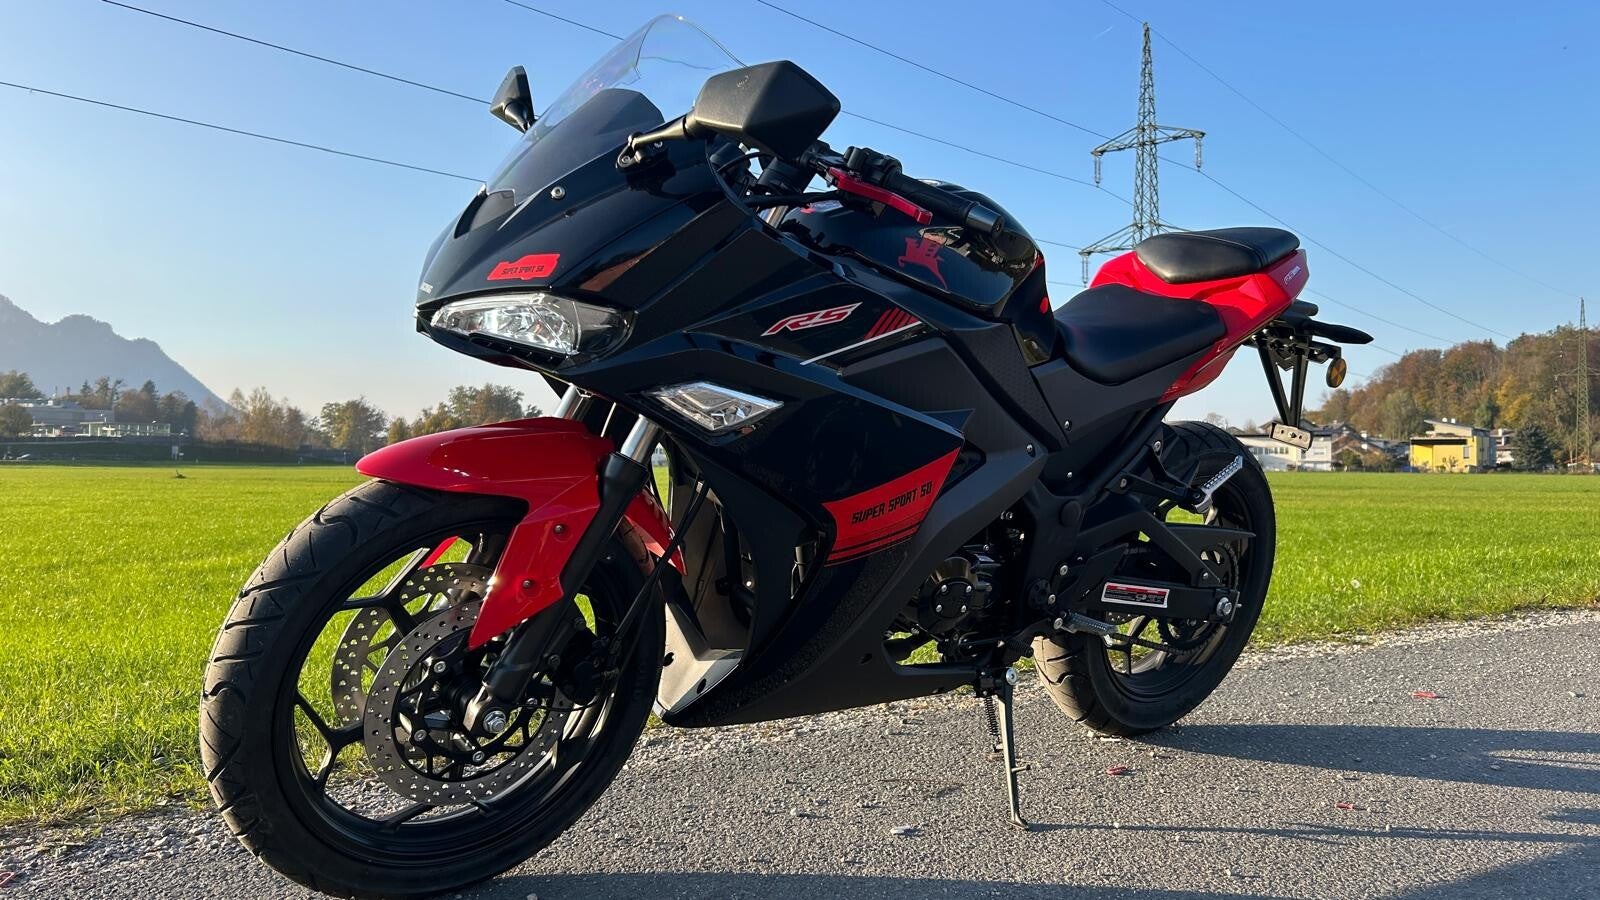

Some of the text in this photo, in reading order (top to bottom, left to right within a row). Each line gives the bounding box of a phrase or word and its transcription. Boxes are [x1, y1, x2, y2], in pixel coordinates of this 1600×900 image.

[760, 301, 863, 337] RS
[851, 481, 933, 524] SUPER SPORT 50
